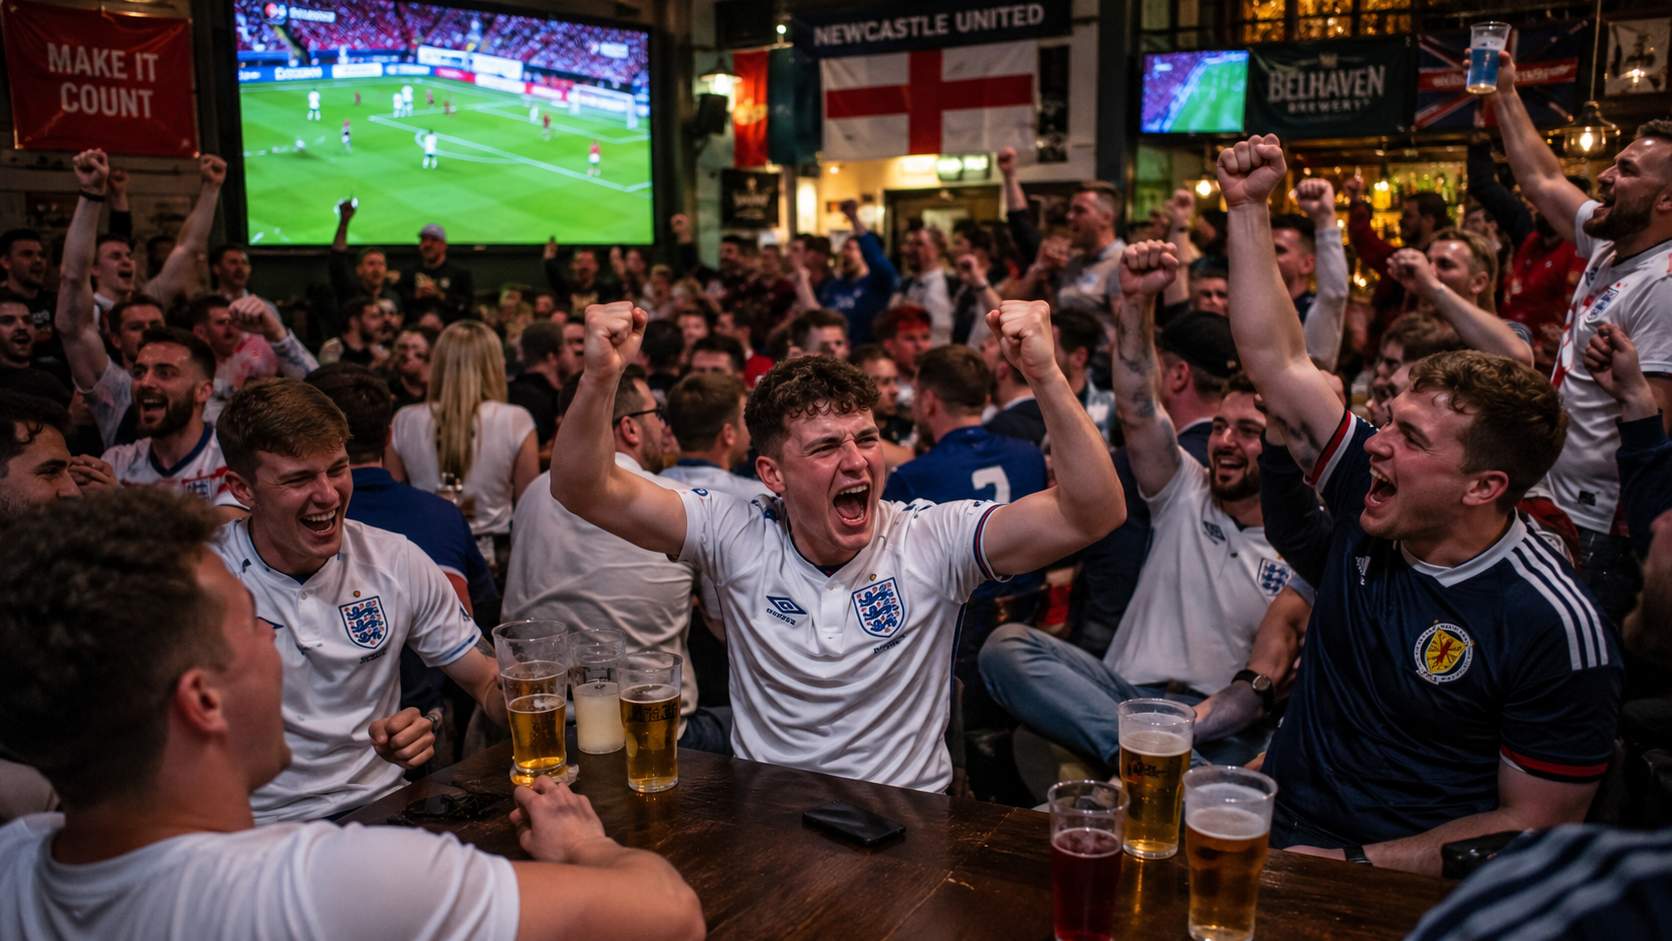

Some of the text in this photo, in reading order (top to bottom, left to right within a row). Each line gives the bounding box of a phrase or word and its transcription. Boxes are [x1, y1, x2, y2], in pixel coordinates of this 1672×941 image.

[814, 4, 1045, 46] NEWCASTLE UNITED
[48, 43, 159, 82] MAKE IT
[61, 83, 154, 119] COUNT
[1268, 65, 1386, 103] BELHAVEN
